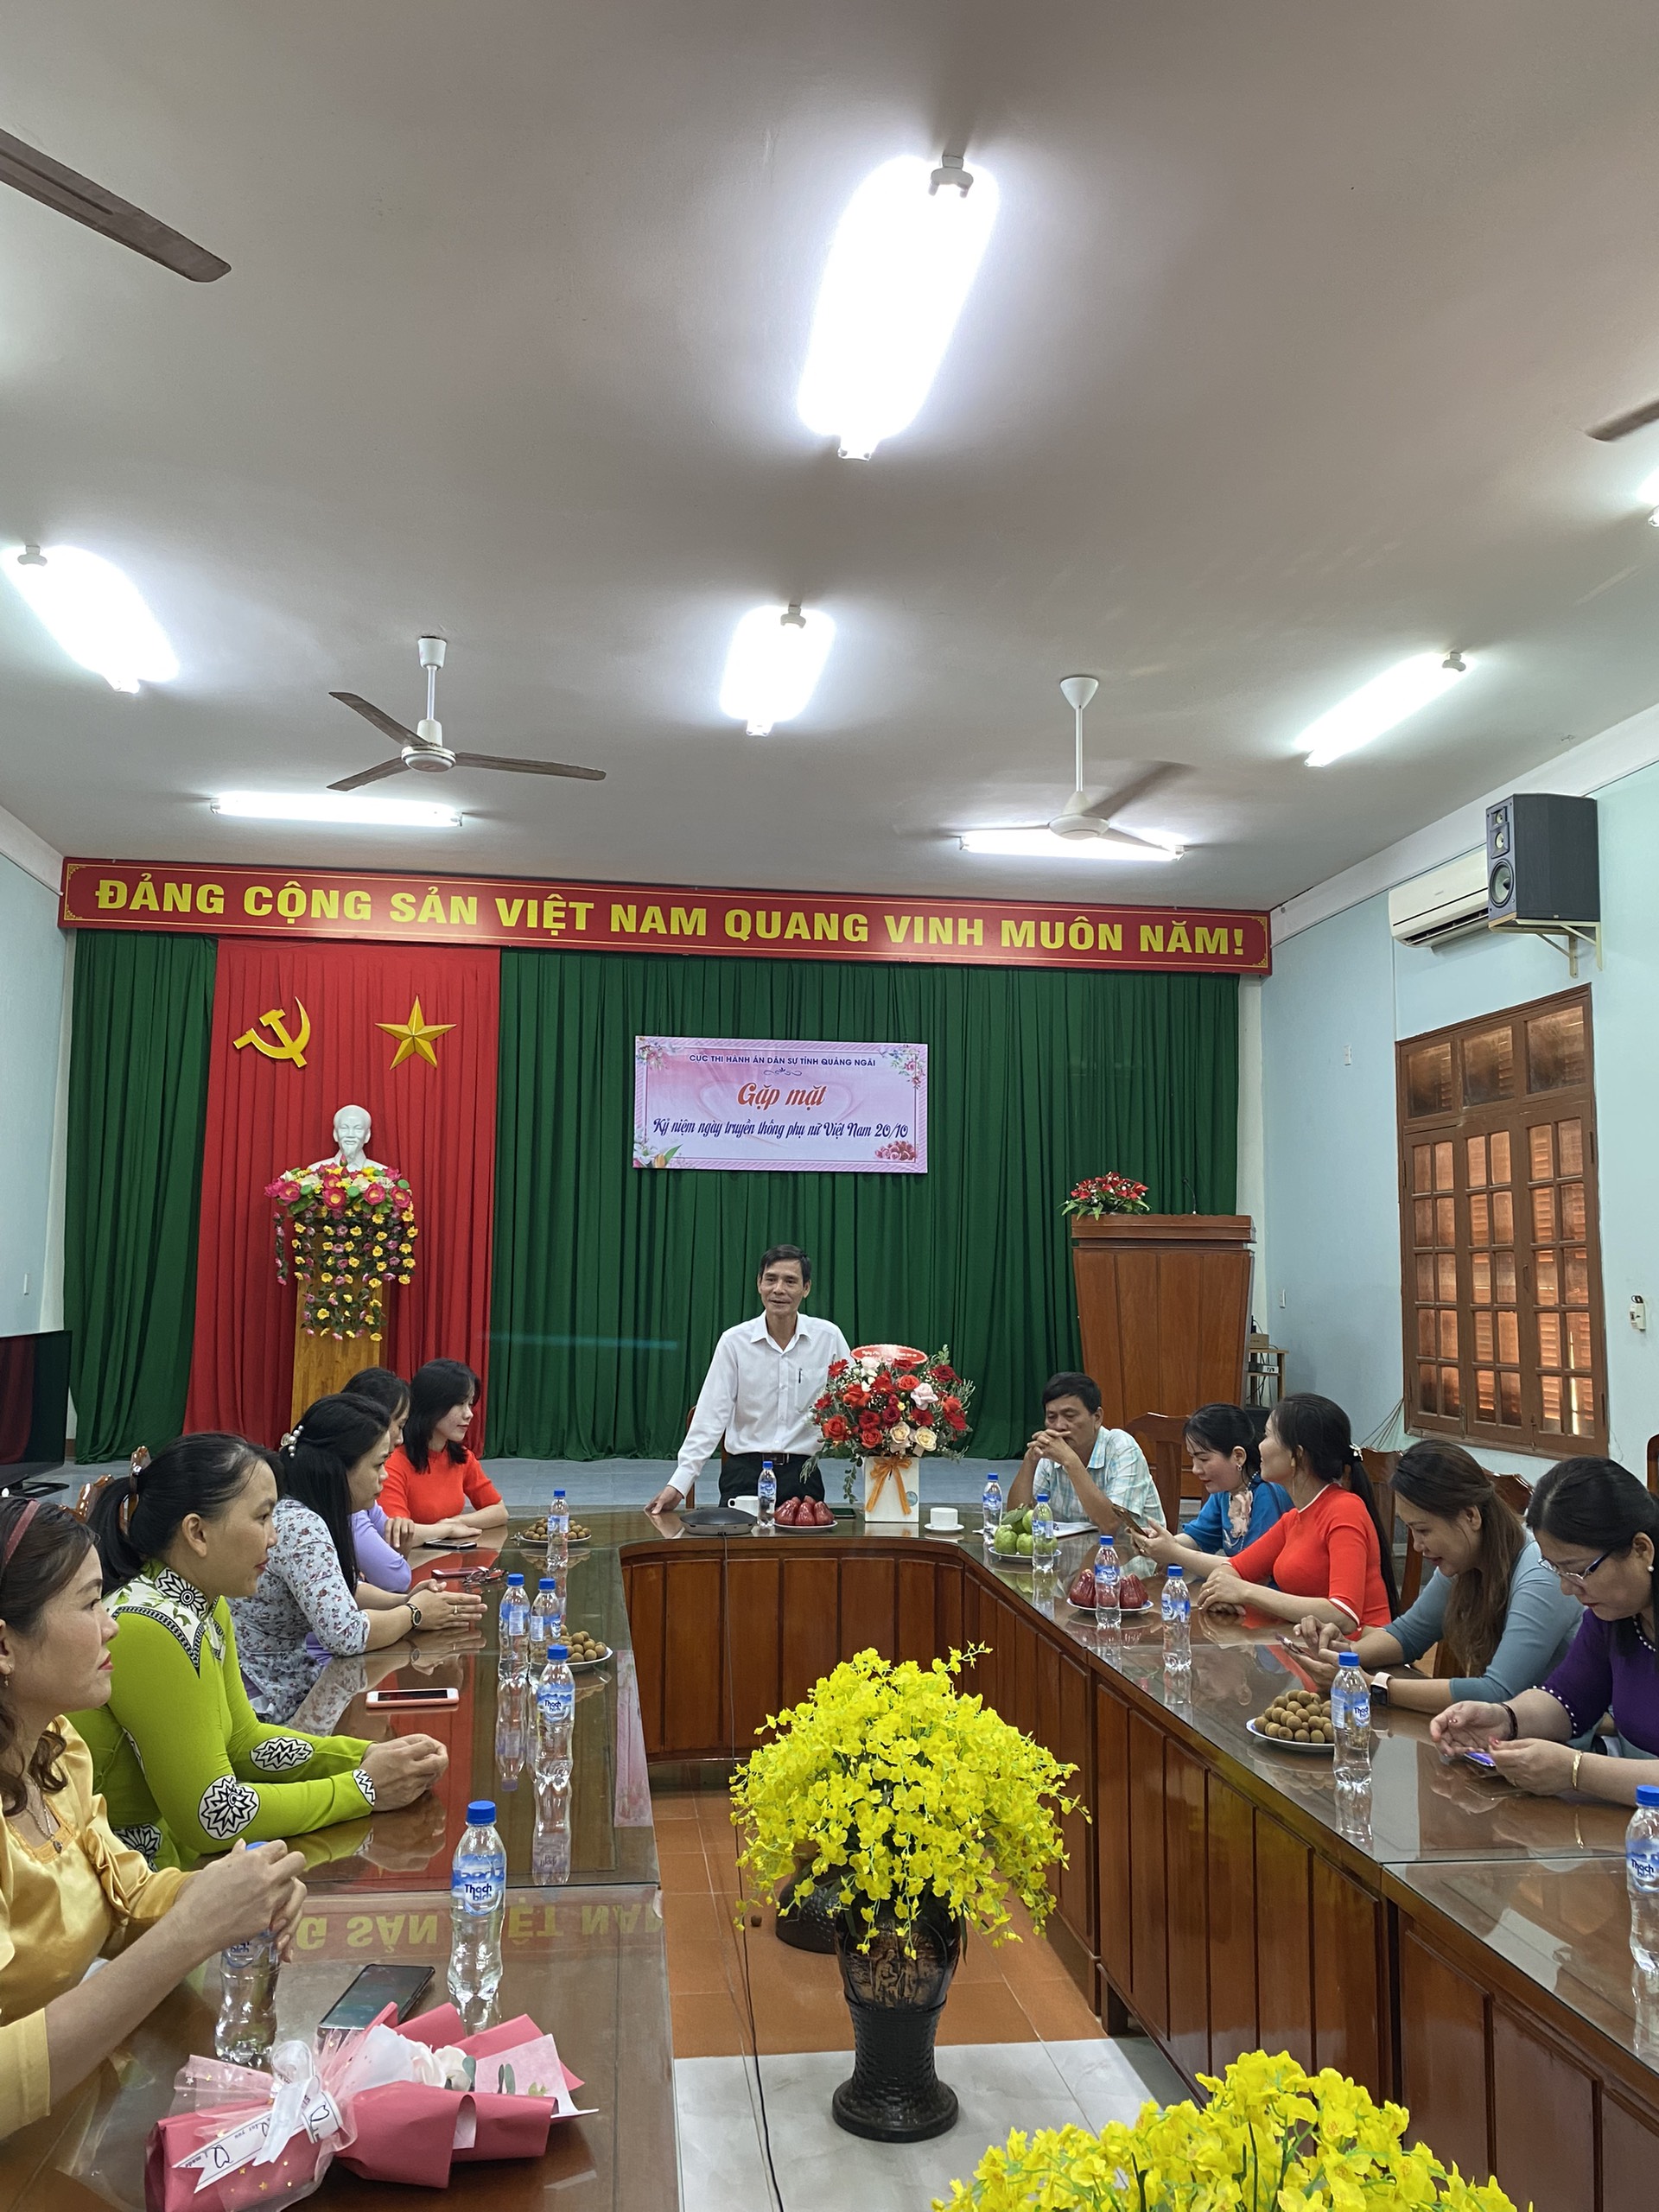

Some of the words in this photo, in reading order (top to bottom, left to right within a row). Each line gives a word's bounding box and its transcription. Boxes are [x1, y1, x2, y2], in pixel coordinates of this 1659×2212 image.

[95, 873, 225, 914] ĐẢNG
[244, 880, 372, 925] CỘNG
[389, 886, 478, 927] SẢN
[494, 893, 594, 937] VIỆT
[610, 904, 707, 936] NAM
[724, 909, 868, 942] QUANG
[884, 915, 984, 947] VINH
[1000, 916, 1122, 951] MUÔN
[1140, 921, 1243, 955] NĂM!
[689, 1054, 709, 1064] CỤC
[726, 1053, 750, 1064] HÀNH
[753, 1054, 765, 1064] ÁN
[767, 1055, 785, 1065] DÂN
[787, 1057, 798, 1066] SỰ
[800, 1056, 819, 1065] TỈNH
[821, 1056, 852, 1066] QUẢNG
[855, 1058, 876, 1067] NGÃI
[737, 1082, 780, 1111] Gặp
[785, 1084, 827, 1111] mặt
[653, 1118, 671, 1136] Kỷ
[671, 1119, 696, 1136] niệm
[697, 1120, 723, 1138] ngày
[724, 1118, 755, 1139] truyền
[757, 1118, 785, 1140] thống
[785, 1121, 805, 1140] phụ
[807, 1122, 823, 1136] nữ
[823, 1122, 845, 1140] Việt
[847, 1122, 872, 1138] Nam
[874, 1122, 909, 1139] 20/10
